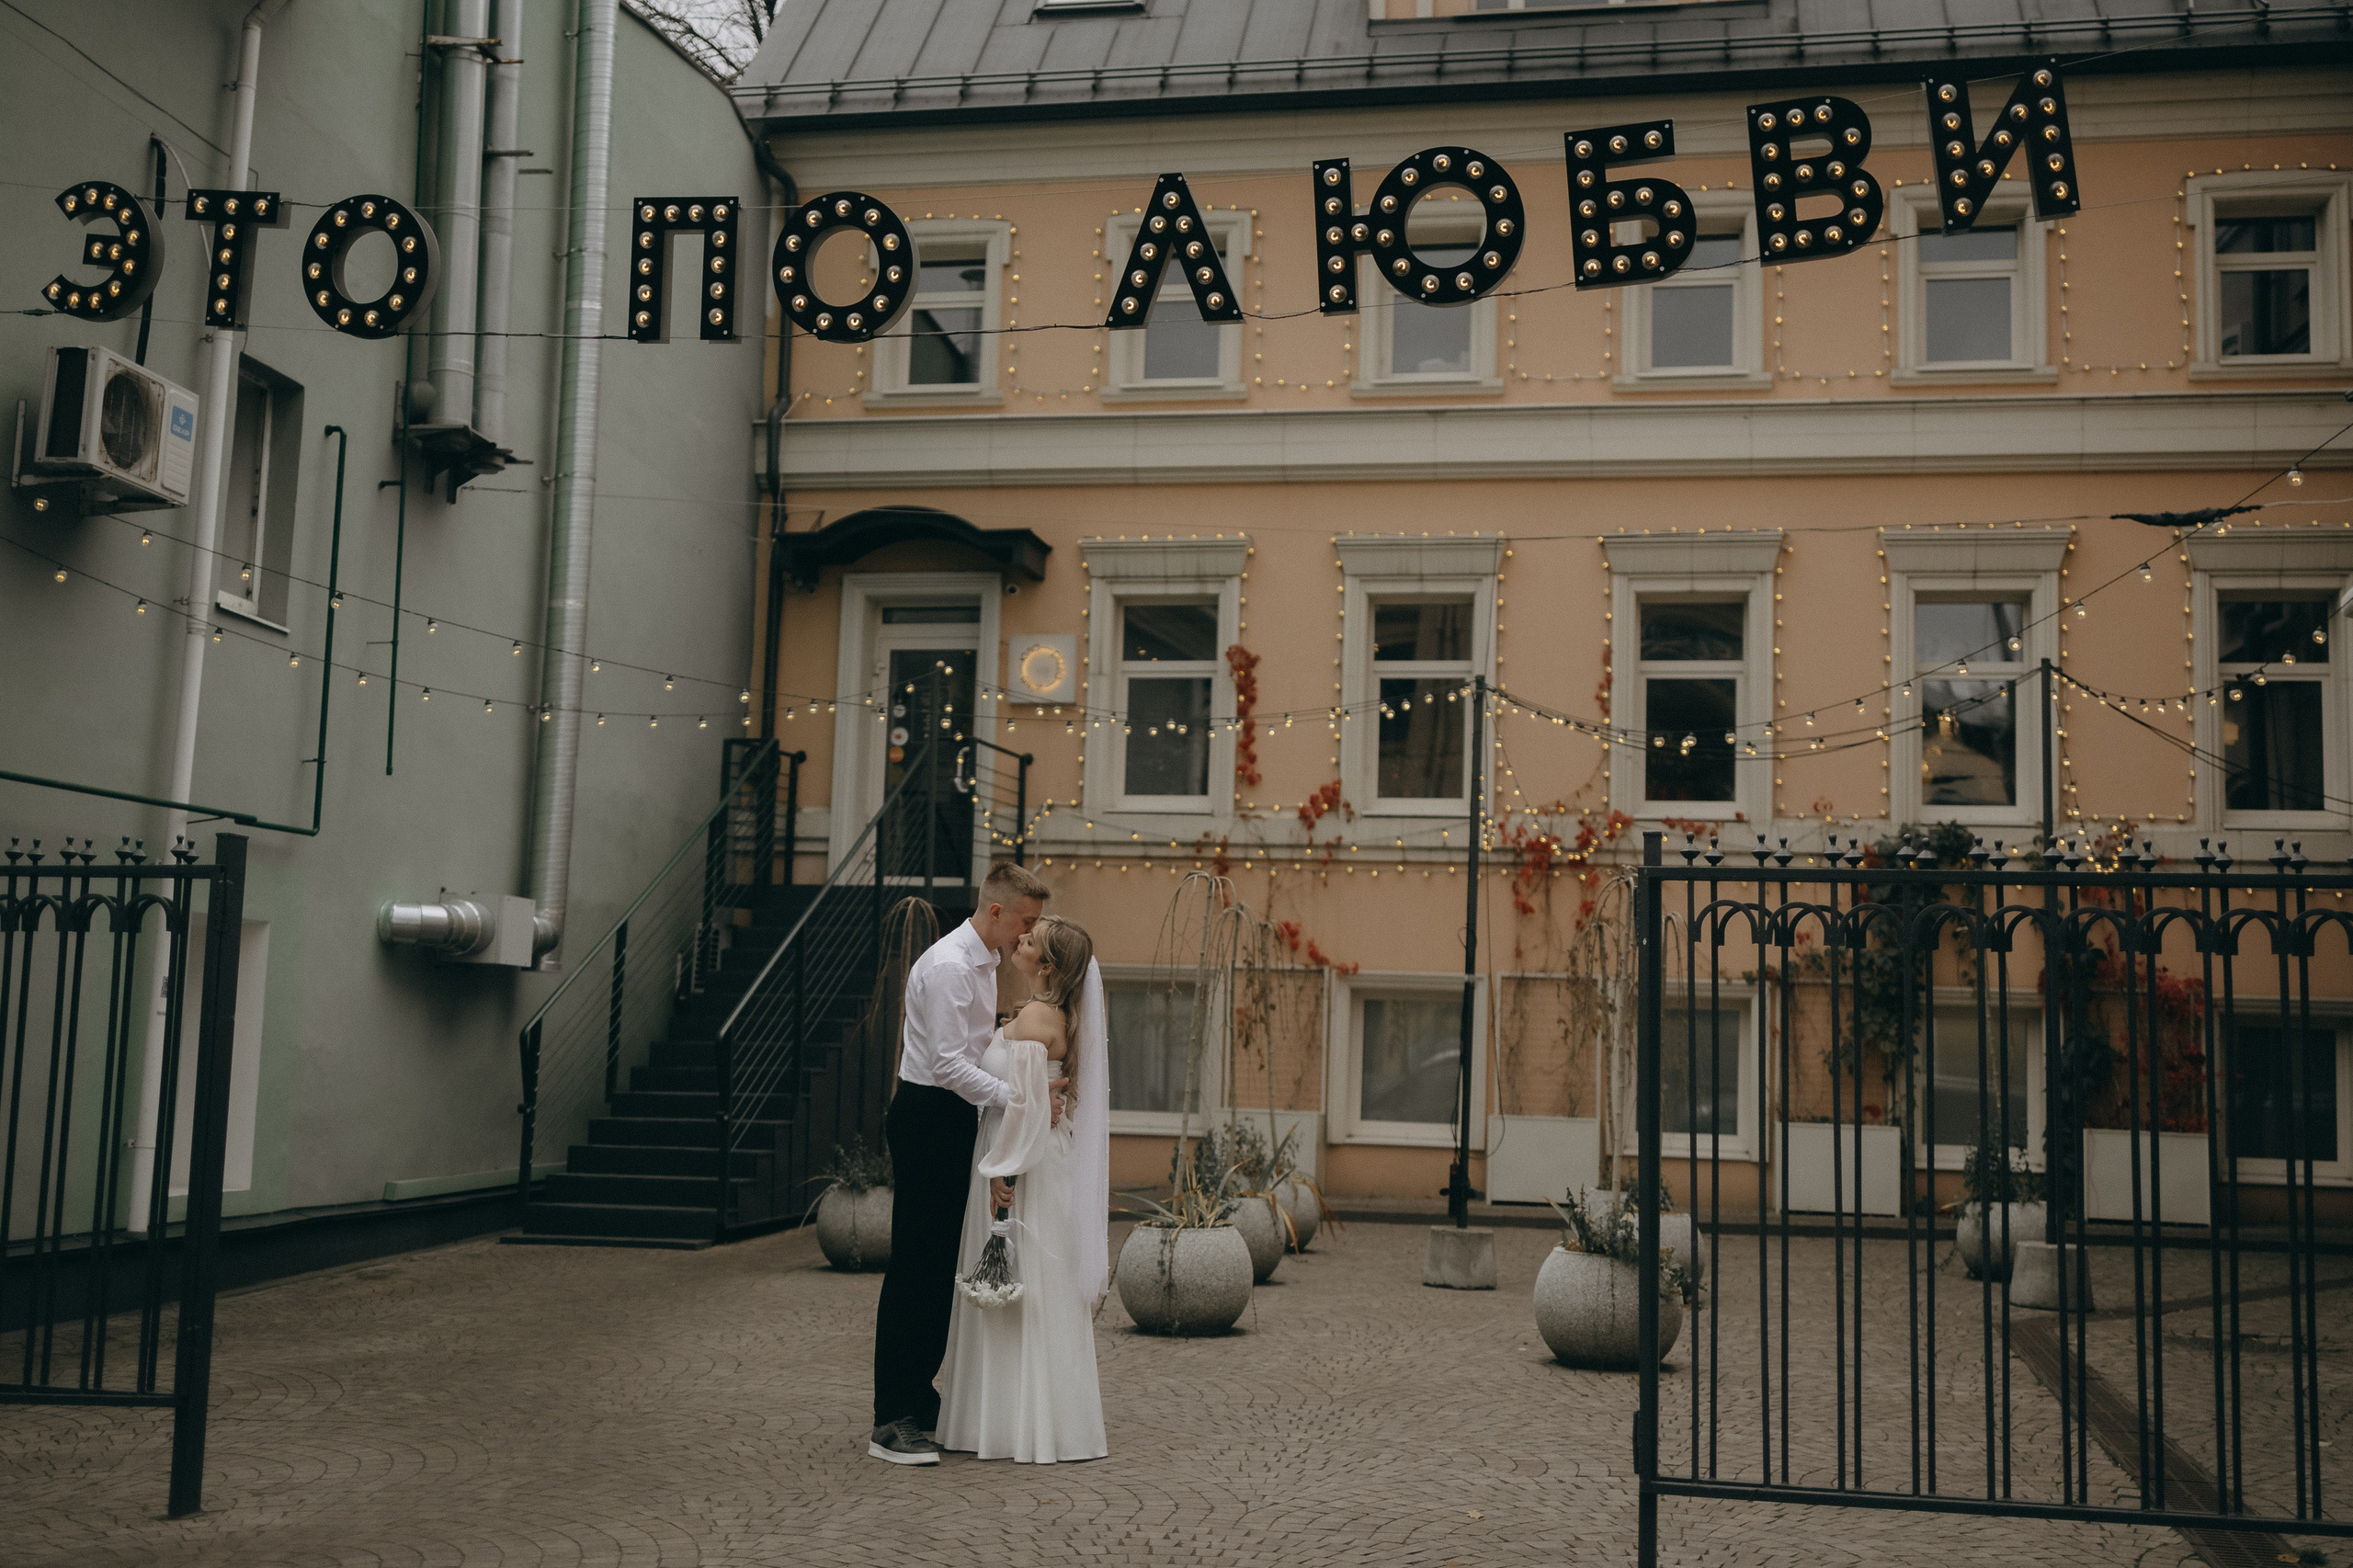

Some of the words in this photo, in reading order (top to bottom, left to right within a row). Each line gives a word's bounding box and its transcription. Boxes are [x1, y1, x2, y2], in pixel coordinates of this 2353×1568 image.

[41, 180, 438, 339] ЭТО
[629, 191, 917, 342] ПО
[1108, 56, 2082, 328] ЛЮБВИ
